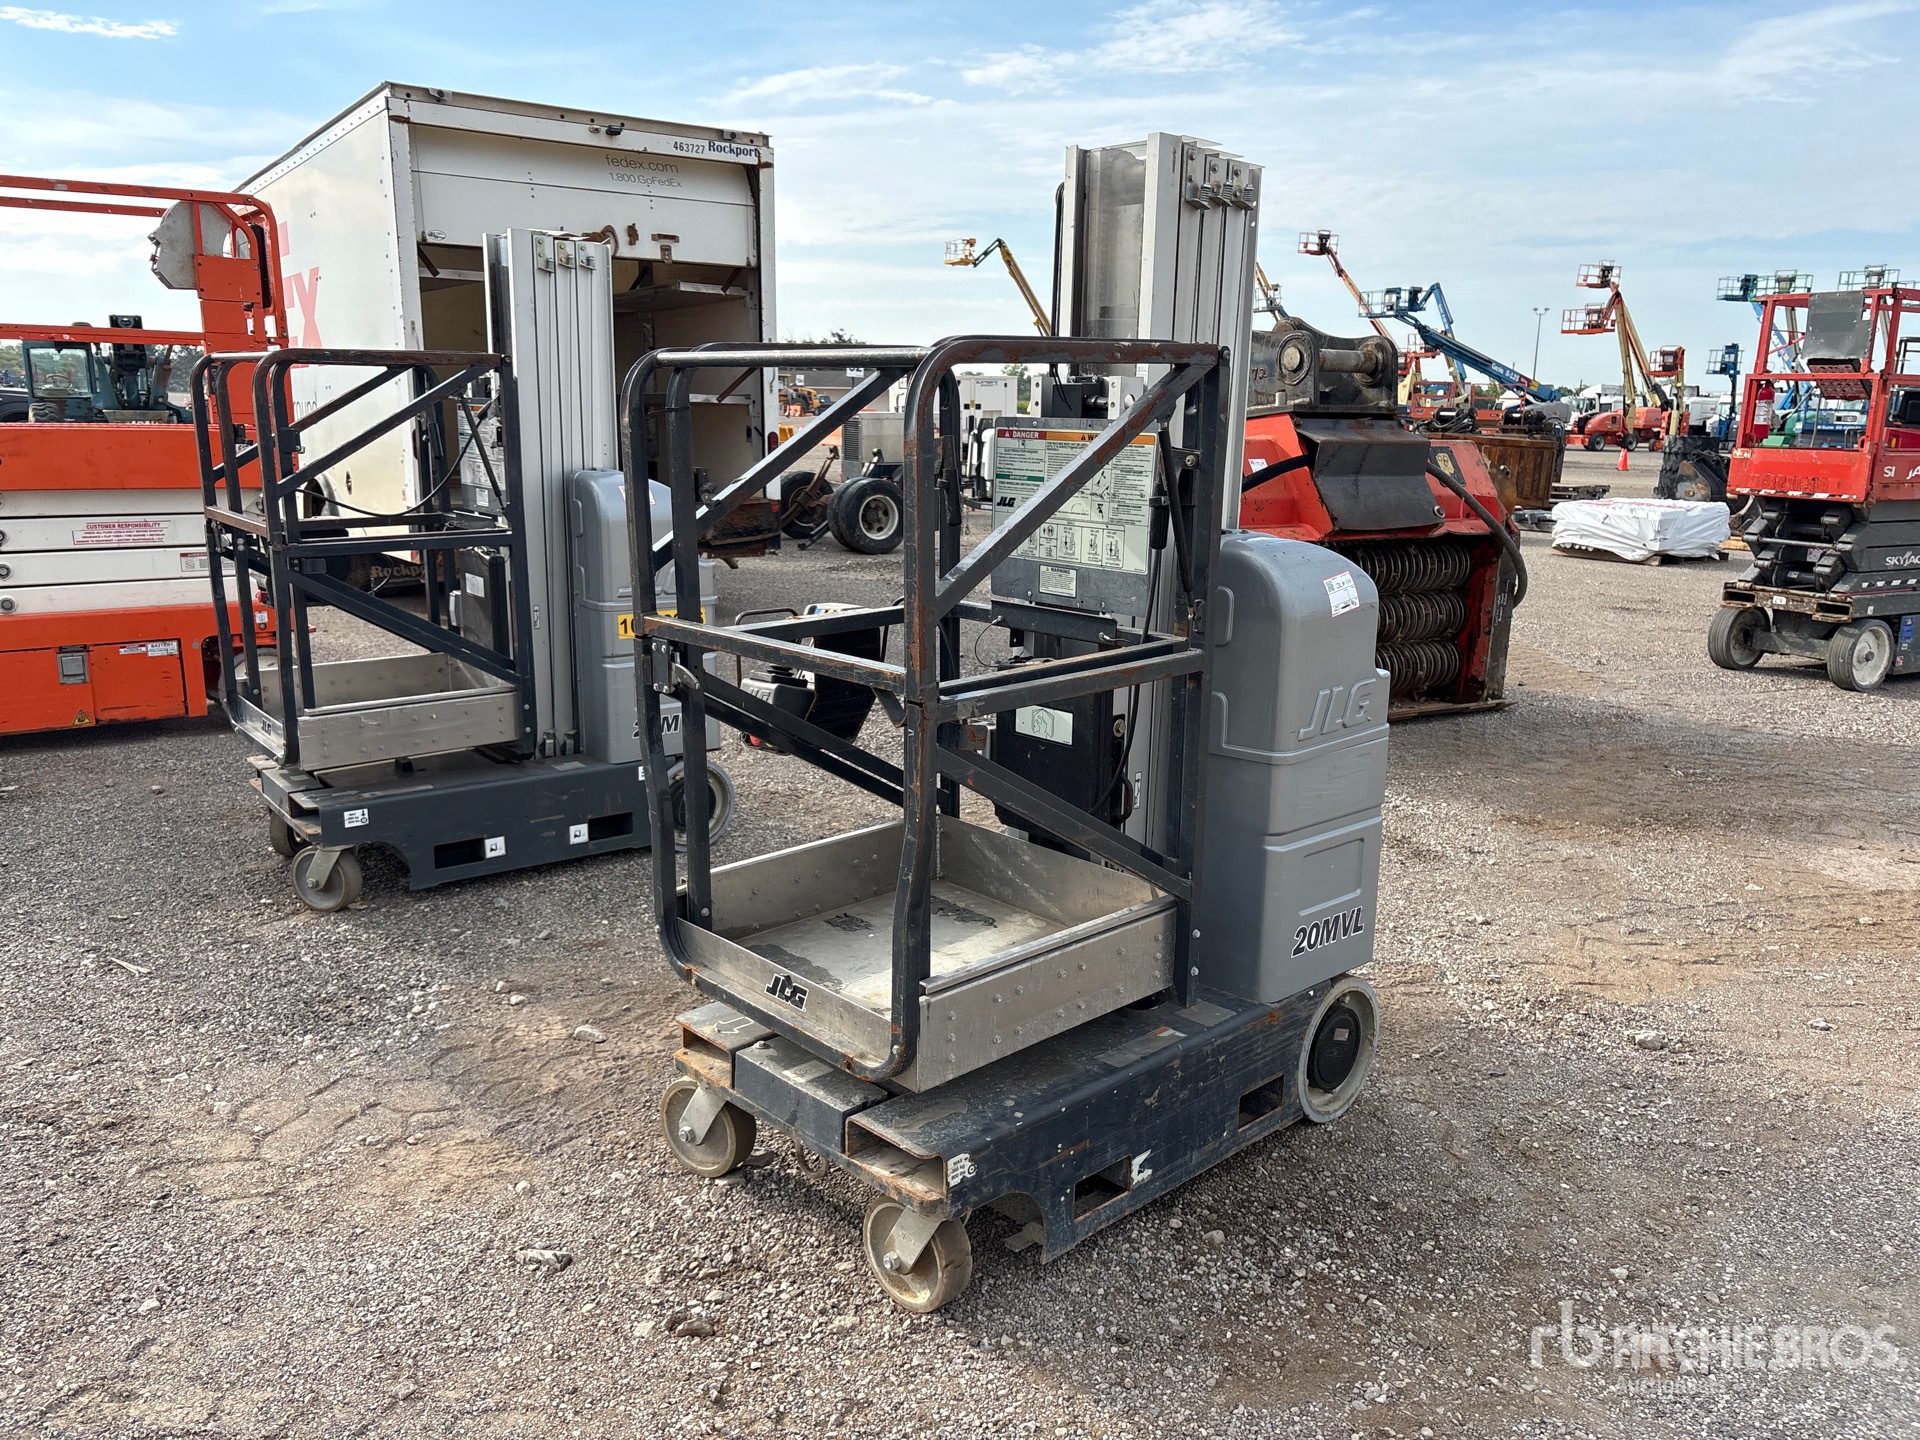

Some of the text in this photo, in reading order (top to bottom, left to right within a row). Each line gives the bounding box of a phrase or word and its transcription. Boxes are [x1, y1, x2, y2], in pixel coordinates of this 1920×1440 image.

[673, 141, 705, 154] 463727
[708, 141, 760, 157] Rockport
[605, 154, 679, 174] fedex.com
[609, 172, 683, 188] 1.800.GoFedEx
[1012, 431, 1039, 439] DANGER
[997, 496, 1016, 507] JLG
[1298, 678, 1376, 742] JLG
[1291, 905, 1364, 959] 20MVL
[764, 973, 810, 1012] JLG
